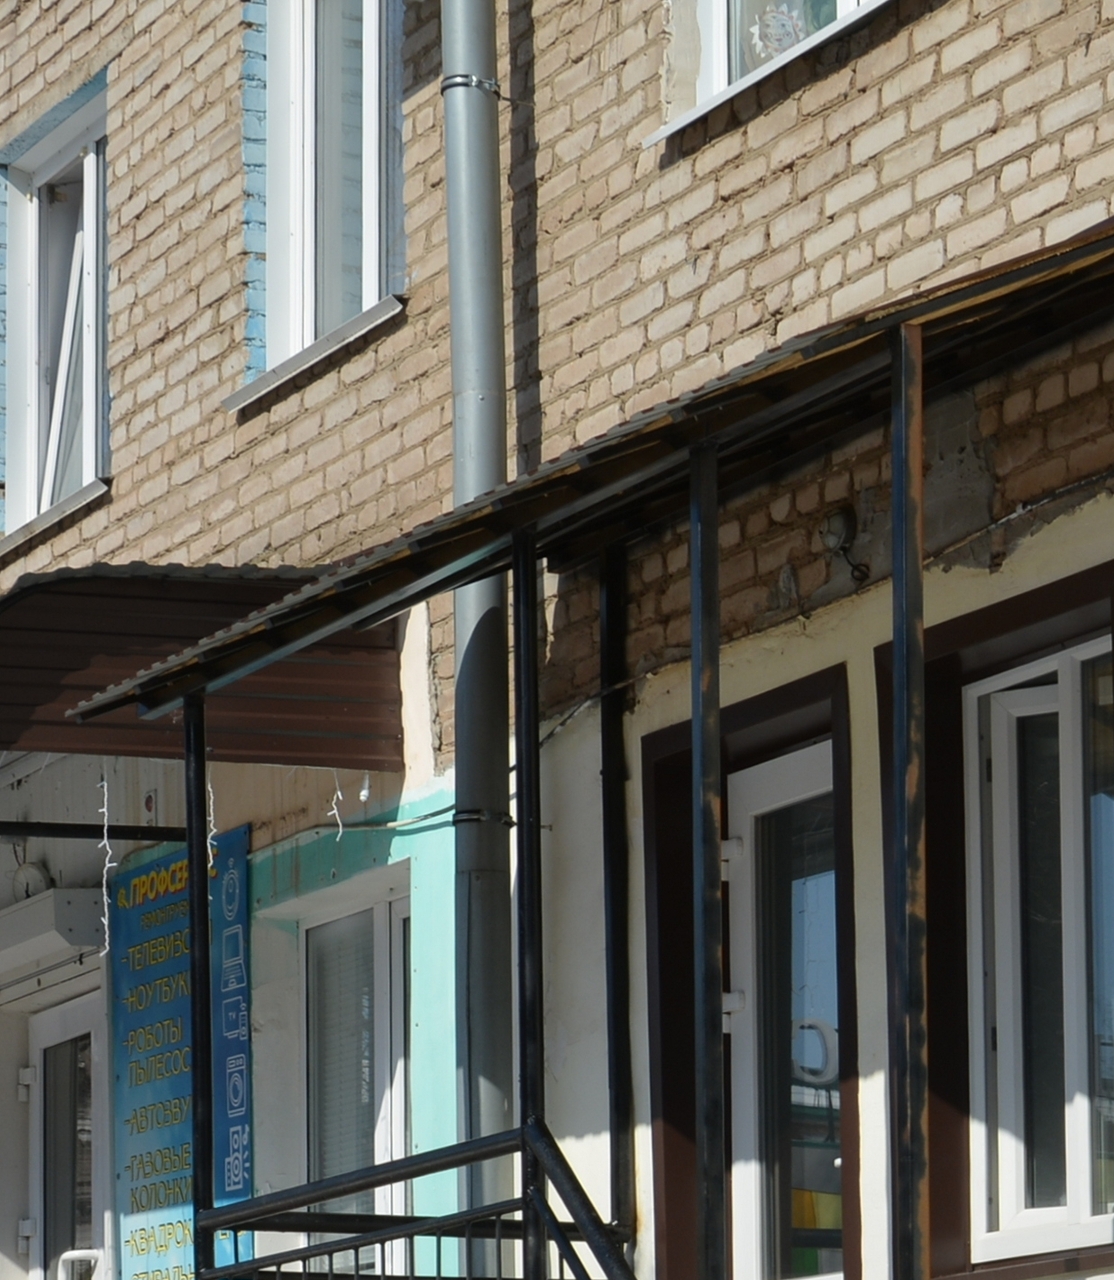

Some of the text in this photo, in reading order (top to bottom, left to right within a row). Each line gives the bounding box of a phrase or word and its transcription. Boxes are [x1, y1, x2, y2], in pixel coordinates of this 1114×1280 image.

[122, 970, 191, 1013] -НОУТБУК
[129, 1046, 191, 1088] ПЫЛЕСОС
[124, 1095, 193, 1136] -АВТОЗВУ
